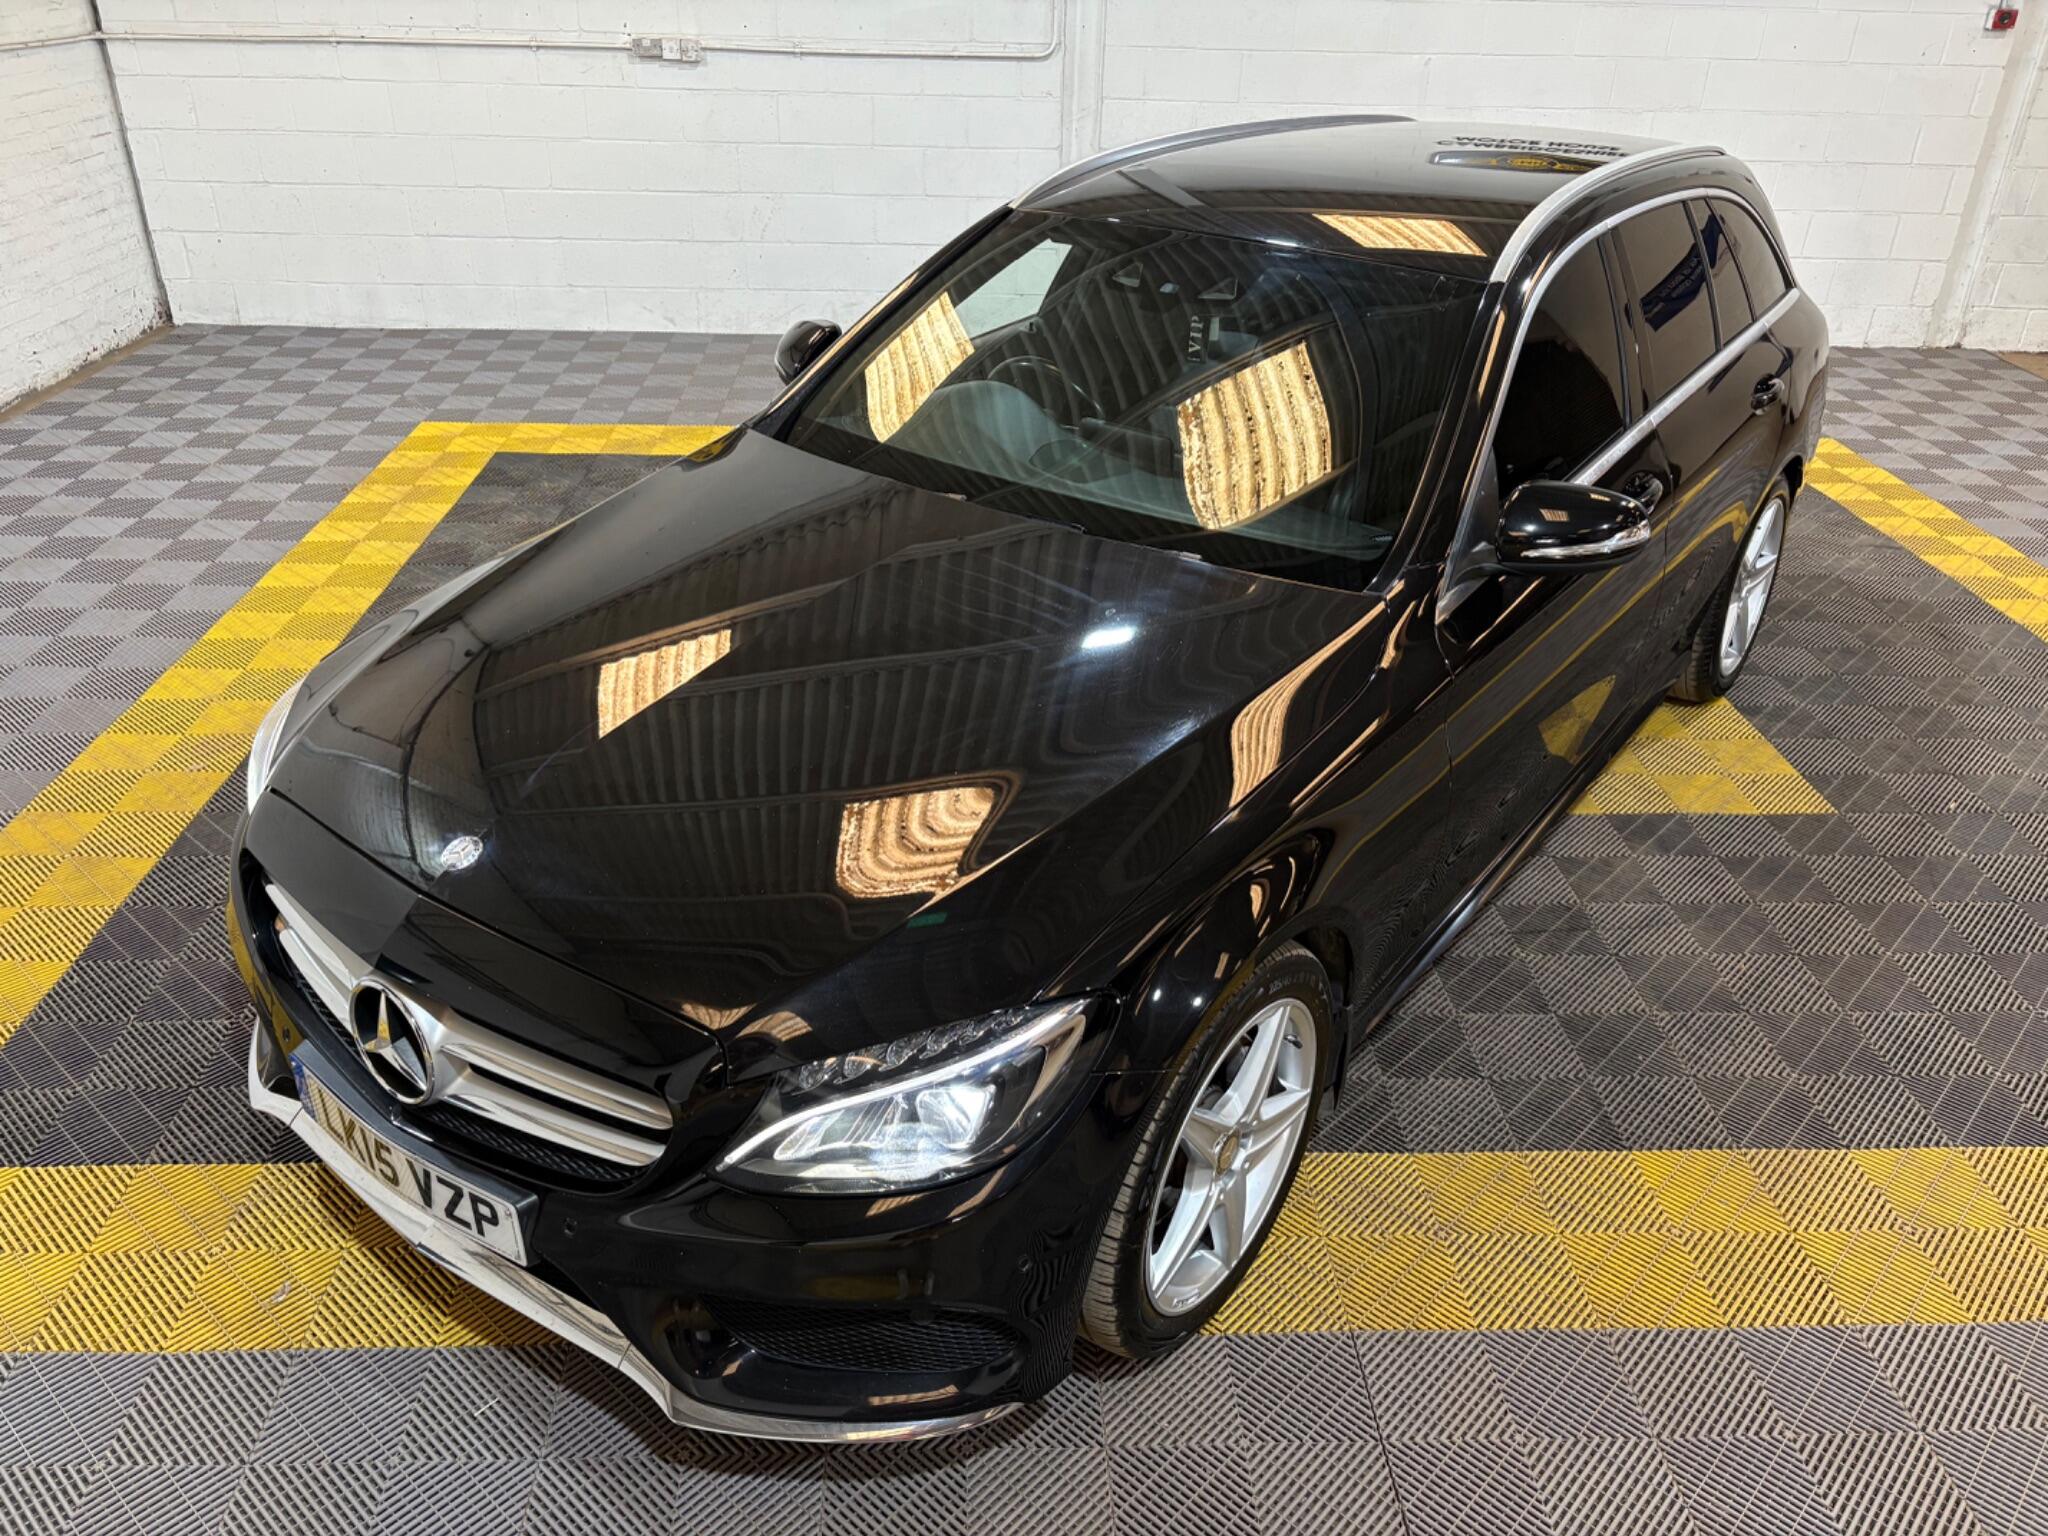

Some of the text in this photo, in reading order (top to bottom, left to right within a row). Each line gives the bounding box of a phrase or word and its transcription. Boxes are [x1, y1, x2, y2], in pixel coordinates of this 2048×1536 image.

[1189, 315, 1204, 352] VIP
[318, 1087, 500, 1237] LK15 VZP
